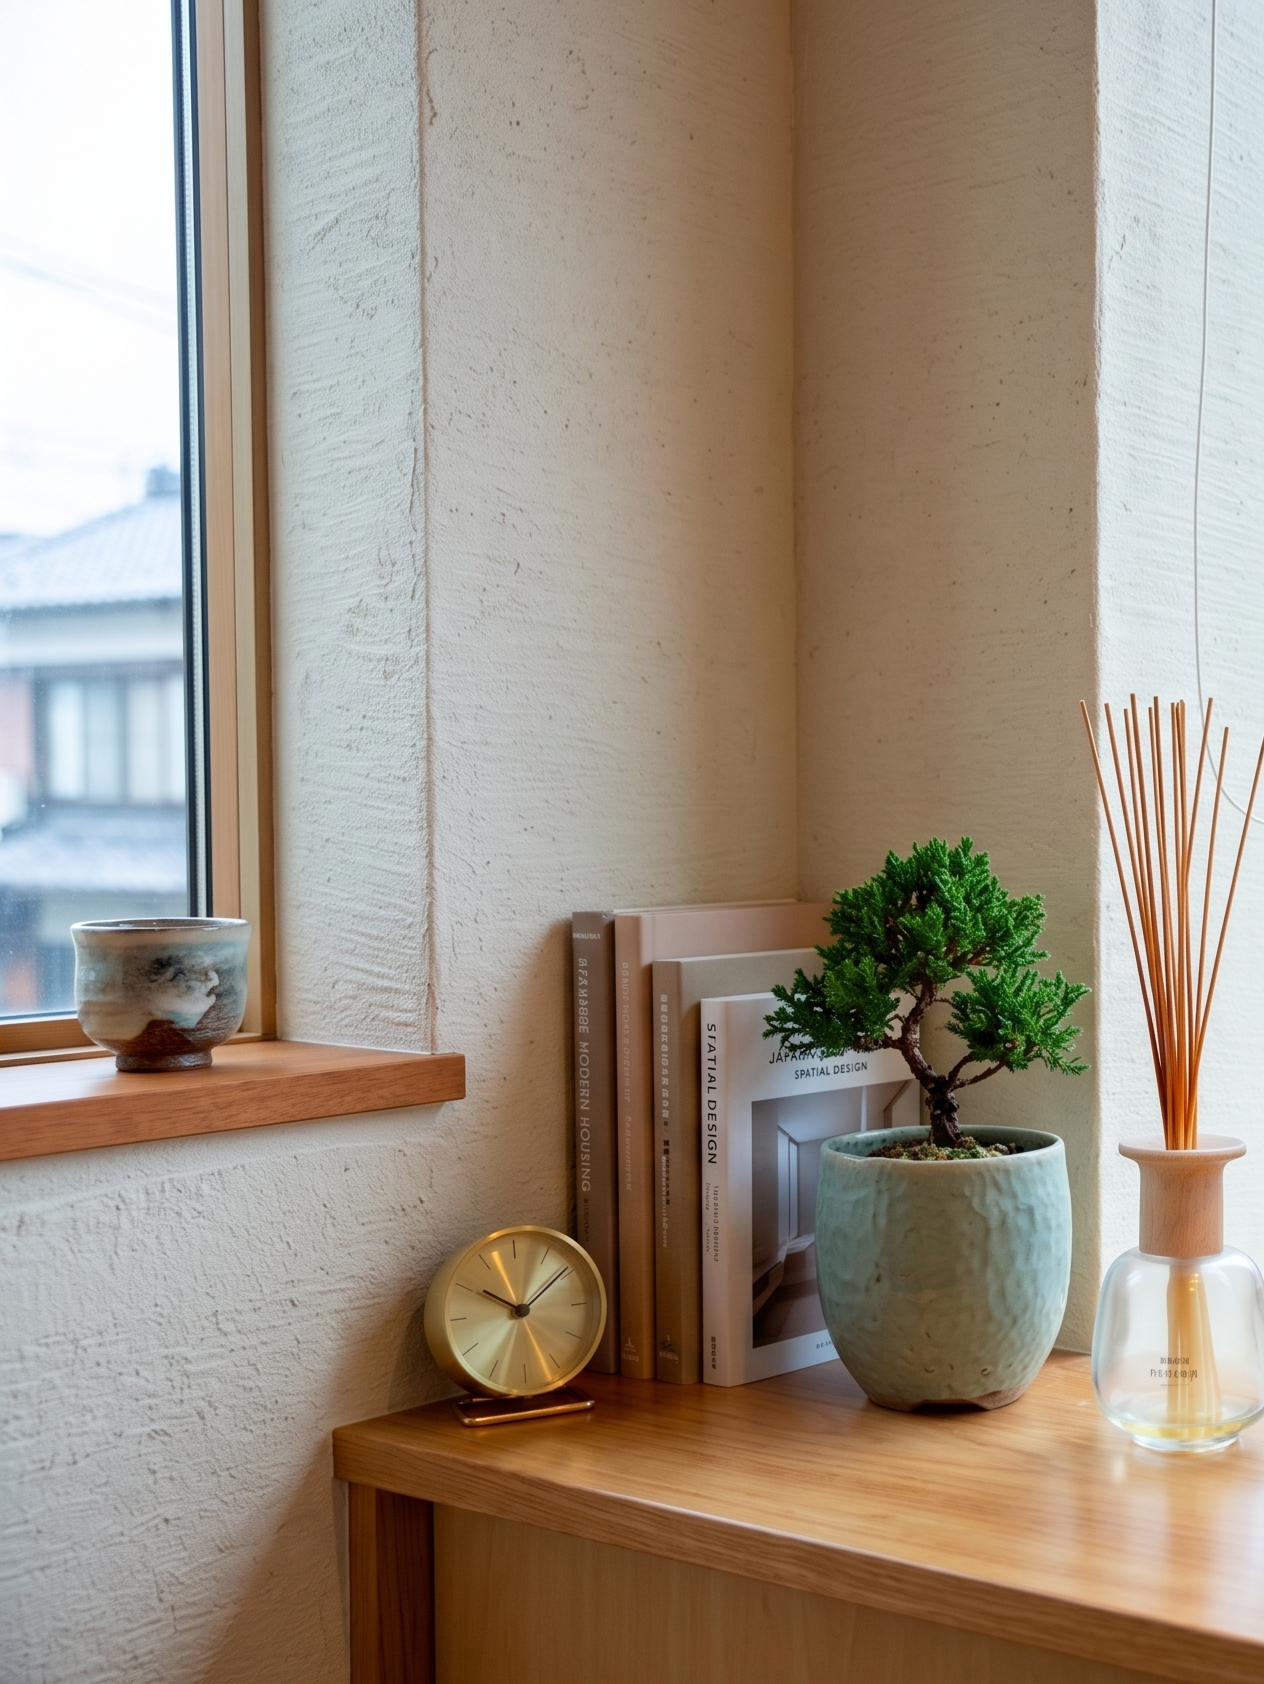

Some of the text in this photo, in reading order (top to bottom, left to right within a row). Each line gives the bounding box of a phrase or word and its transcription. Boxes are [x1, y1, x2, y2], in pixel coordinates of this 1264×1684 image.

[794, 1061, 868, 1080] SPATIAL DESIGN
[580, 1117, 591, 1193] HOUSING
[707, 1100, 718, 1164] DESIGN
